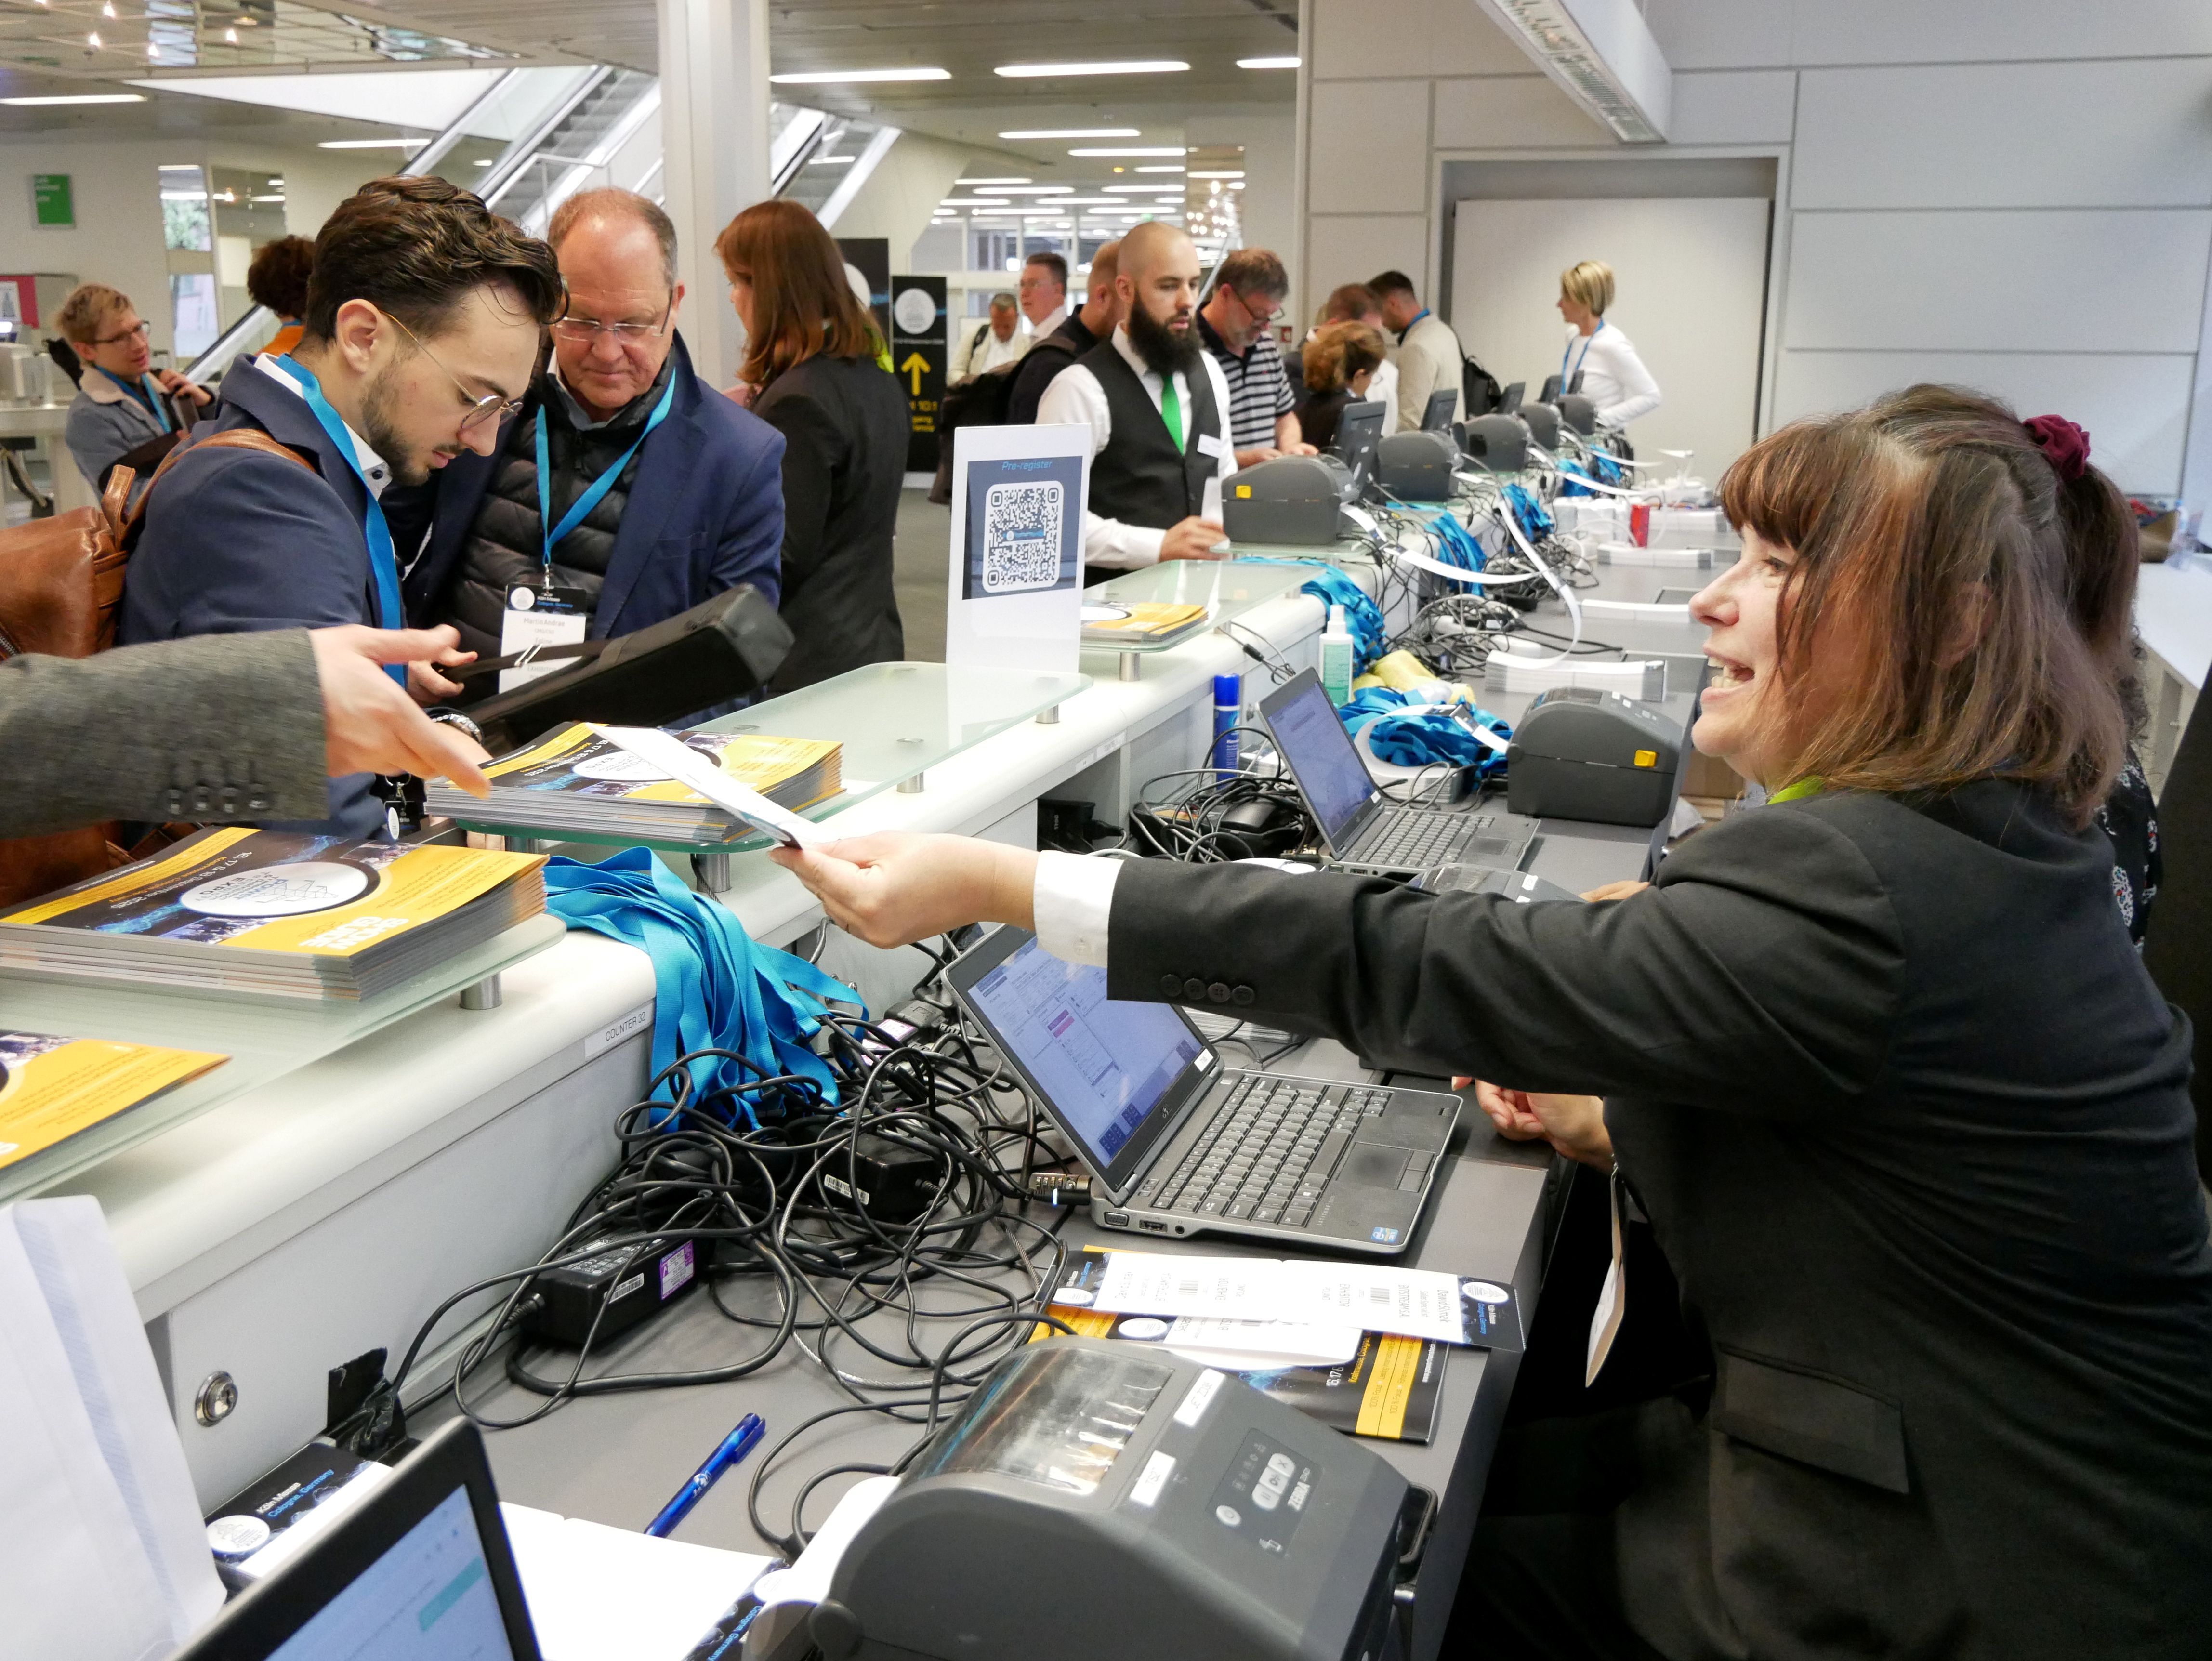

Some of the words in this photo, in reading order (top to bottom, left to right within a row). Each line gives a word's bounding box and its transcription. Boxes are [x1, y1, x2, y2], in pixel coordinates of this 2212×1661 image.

[1002, 460, 1053, 471] Pre-register
[145, 876, 202, 897] September
[198, 877, 246, 895] EXPO
[110, 896, 146, 908] 2025
[297, 921, 343, 937] 2025
[298, 916, 382, 947] GUIDE
[327, 917, 409, 949] SHOW
[605, 1016, 637, 1041] COUNTER
[638, 1011, 646, 1024] 32
[1339, 1283, 1350, 1307] EXHIBITOR
[1398, 1284, 1409, 1309] BITSTREAM
[1437, 1289, 1449, 1305] Dawid
[1356, 1337, 1372, 1356] Cologne,
[1348, 1357, 1366, 1382] Koelnmesse,
[1326, 1378, 1341, 1386] 16,
[256, 1499, 277, 1514] Köln
[273, 1482, 302, 1503] Messe
[268, 1493, 303, 1519] Cologne,
[299, 1468, 334, 1494] Germany
[1288, 1482, 1311, 1511] ZEBRA
[733, 1605, 763, 1632] Cologne,
